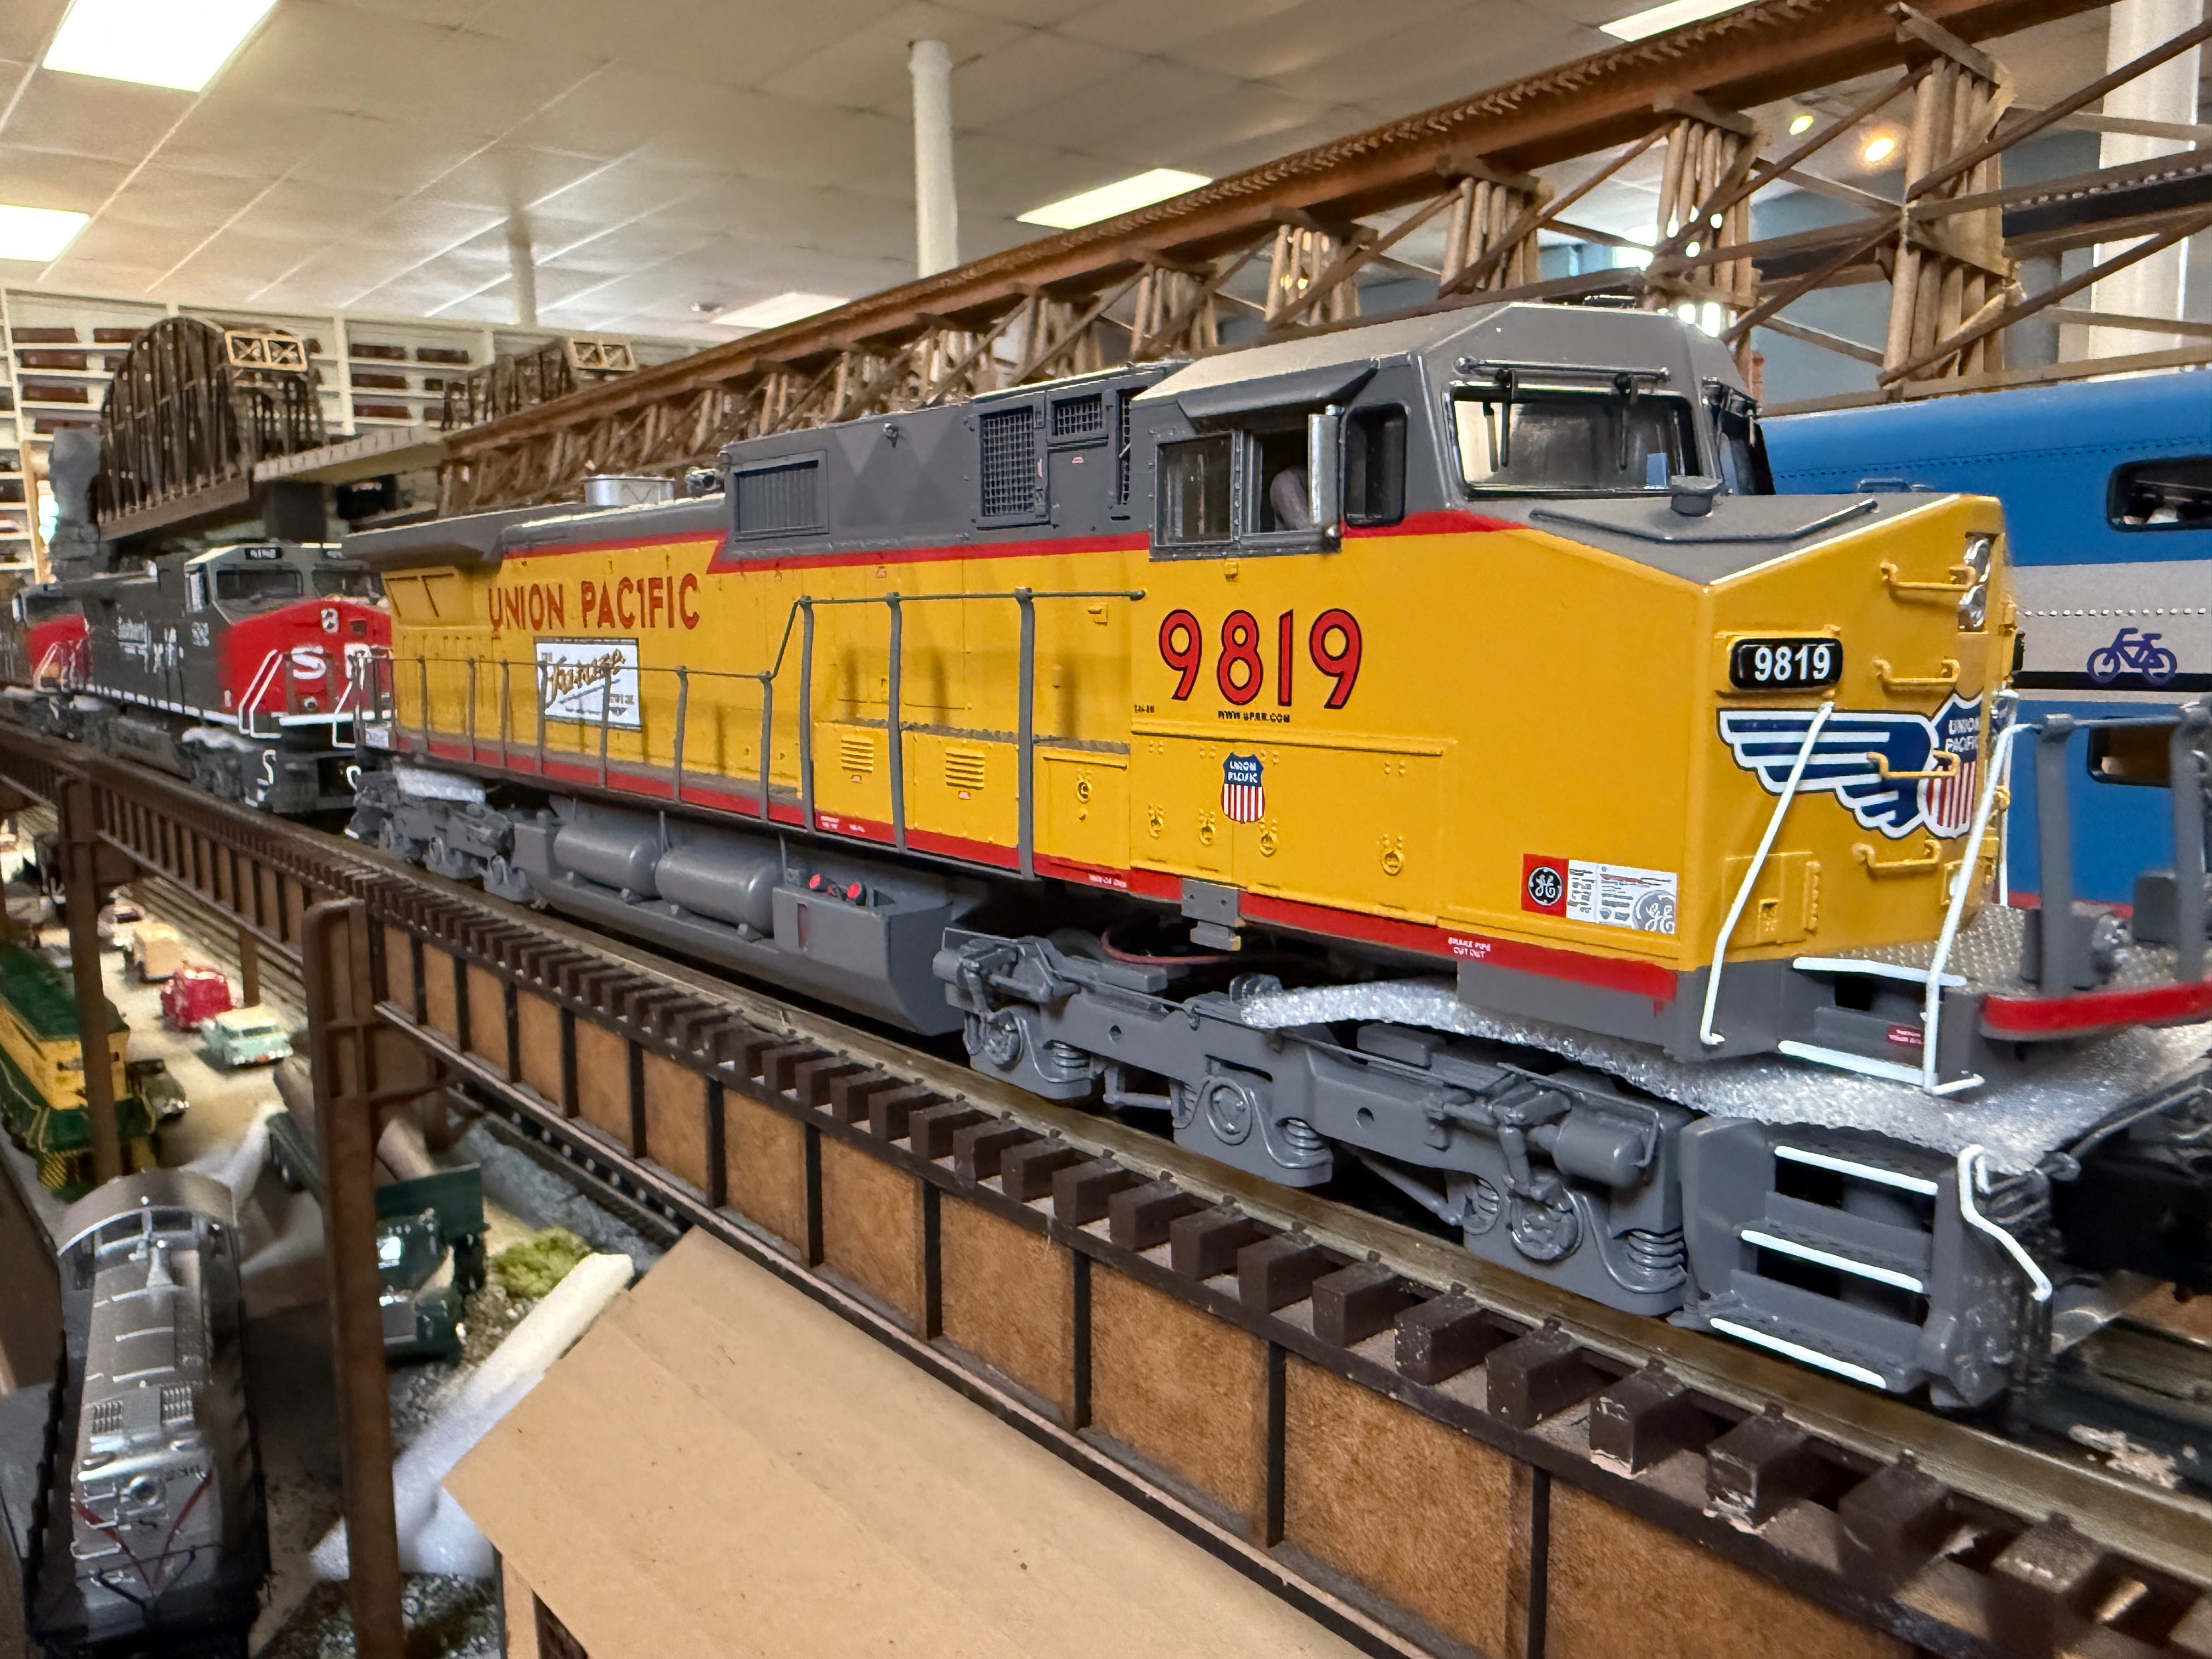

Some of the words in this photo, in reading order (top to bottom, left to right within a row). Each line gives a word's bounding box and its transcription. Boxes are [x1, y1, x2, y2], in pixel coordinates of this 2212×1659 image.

[489, 583, 565, 631] UNION
[580, 572, 700, 630] PACIFIC
[1158, 608, 1363, 709] 9819
[1754, 646, 1831, 681] 9819
